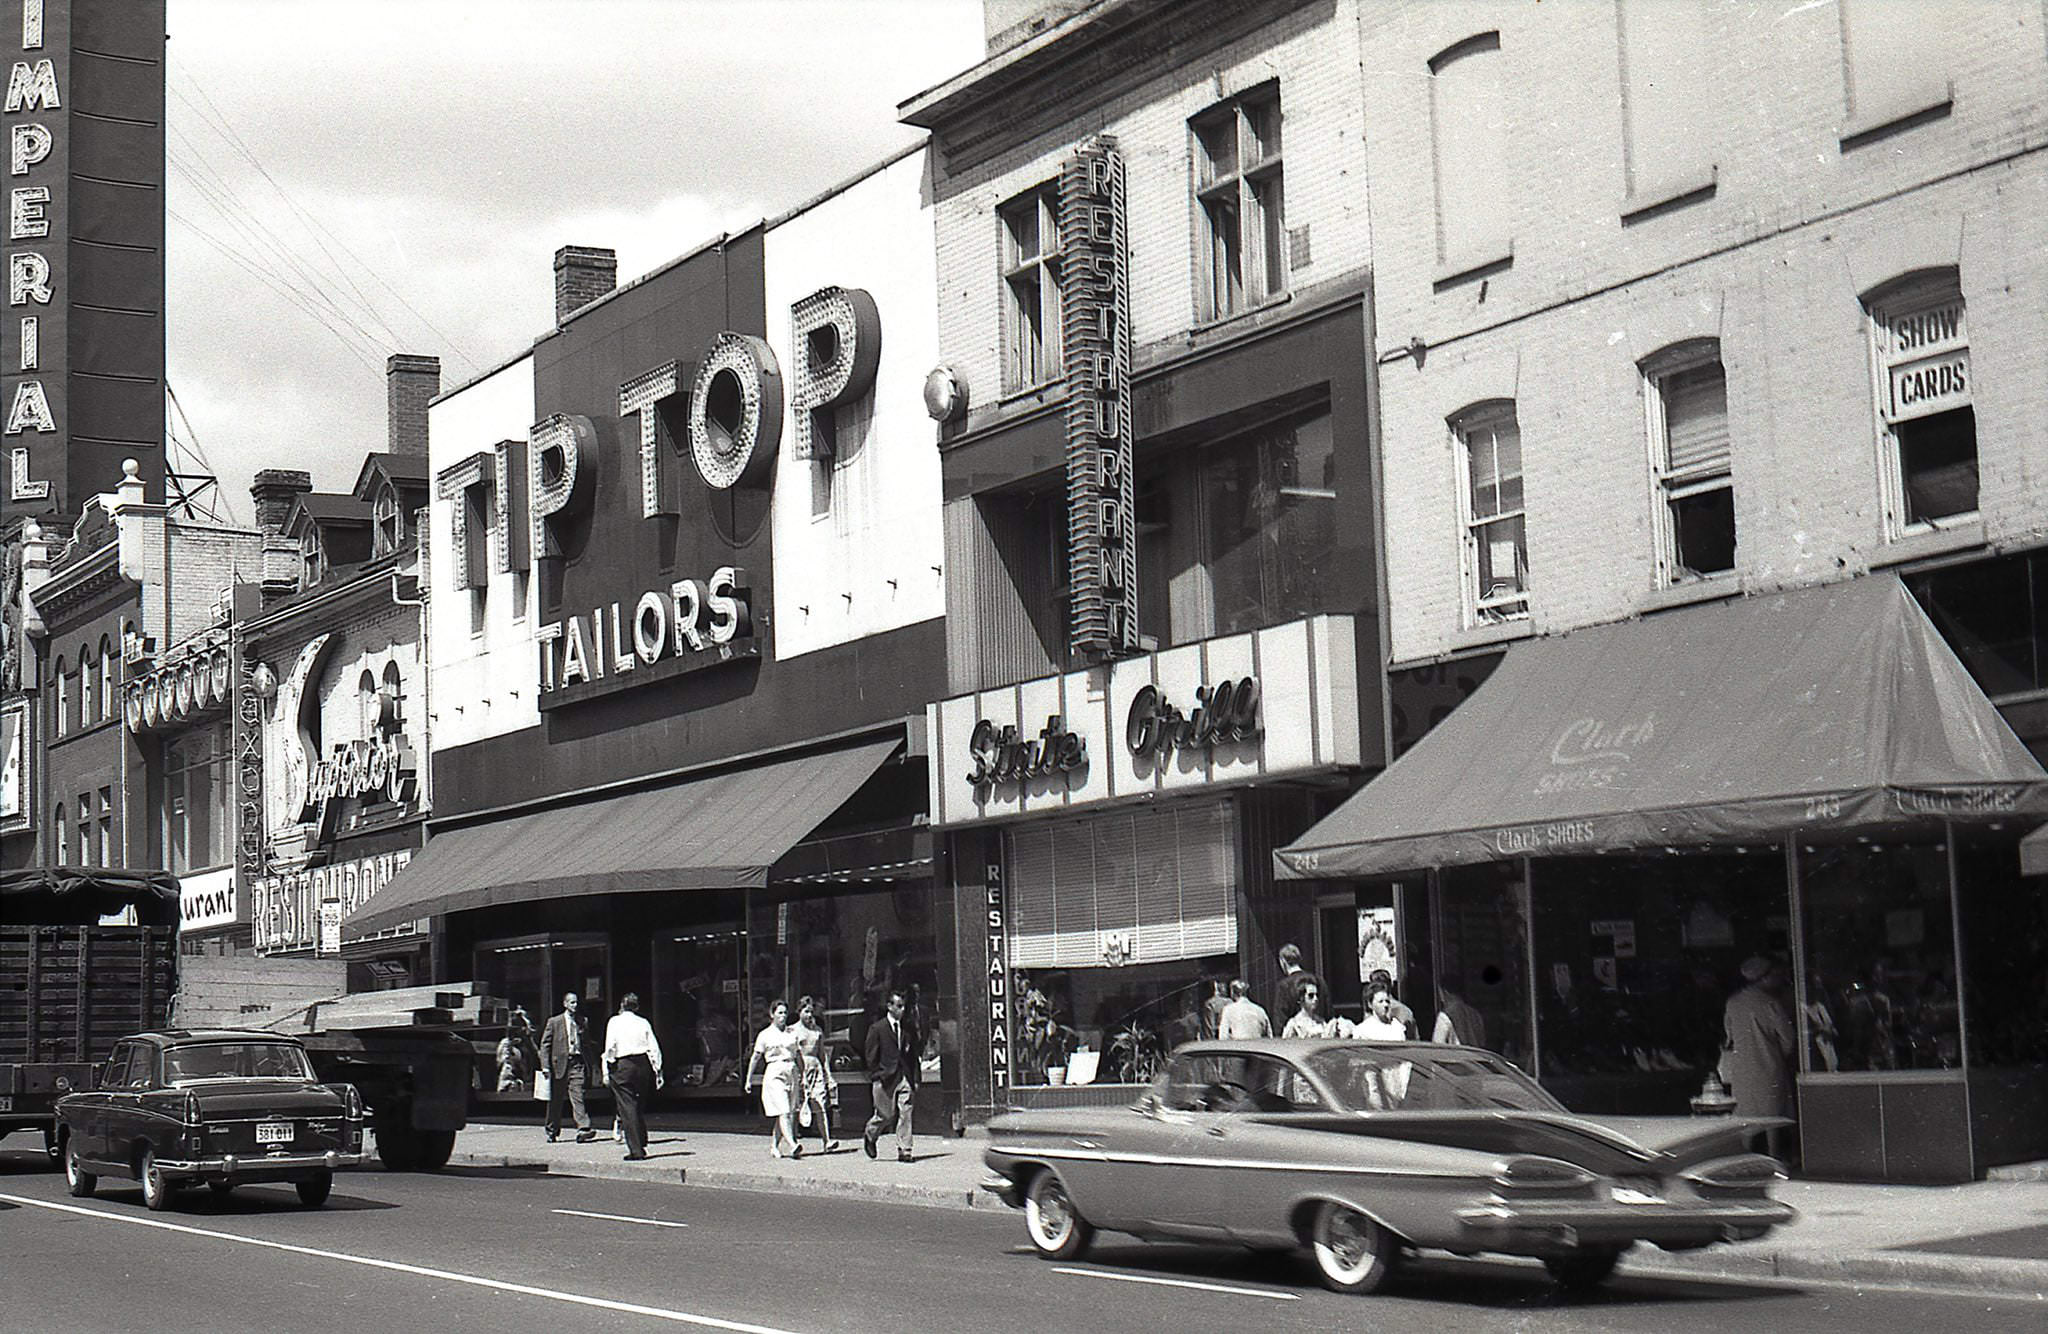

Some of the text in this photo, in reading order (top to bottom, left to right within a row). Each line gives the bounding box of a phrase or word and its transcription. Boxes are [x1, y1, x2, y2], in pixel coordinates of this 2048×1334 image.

[4, 0, 61, 500] IMPERIAL
[1897, 305, 1959, 351] SHOW
[1901, 361, 1965, 405] CARDS
[436, 286, 882, 592] TIP TOP
[1087, 157, 1124, 640] RESTAURANT
[535, 566, 753, 694] TAILORS
[967, 676, 1263, 784] State Grill
[1547, 822, 1594, 844] SHOES
[987, 864, 1008, 1088] RESTAURANT
